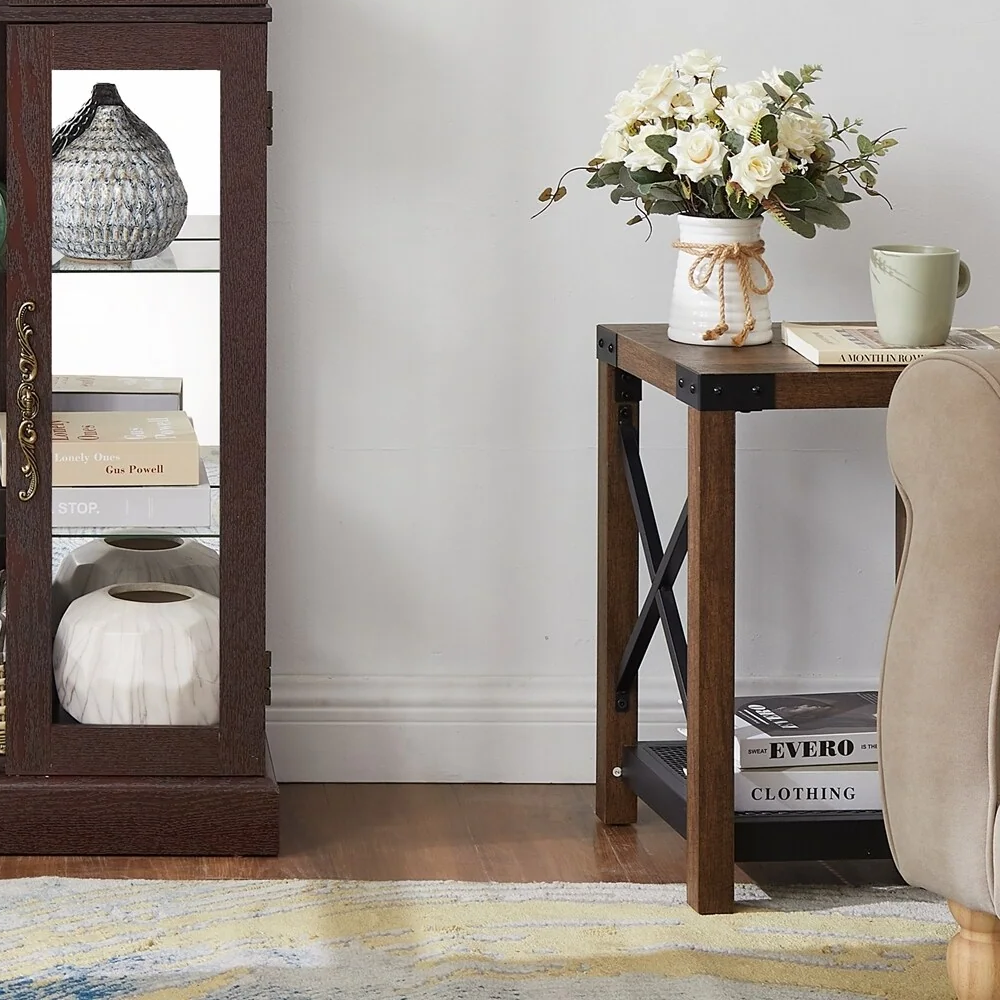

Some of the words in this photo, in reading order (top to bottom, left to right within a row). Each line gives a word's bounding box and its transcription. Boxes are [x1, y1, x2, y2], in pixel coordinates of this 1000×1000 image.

[839, 354, 846, 362] A
[848, 354, 884, 362] MONTH
[885, 354, 897, 362] IN
[54, 453, 90, 464] Lonely
[94, 453, 121, 462] Ones
[105, 465, 125, 474] Gus
[129, 464, 164, 474] Powell
[58, 502, 100, 514] STOP.
[769, 739, 854, 760] EVERO
[751, 787, 856, 801] CLOTHING
